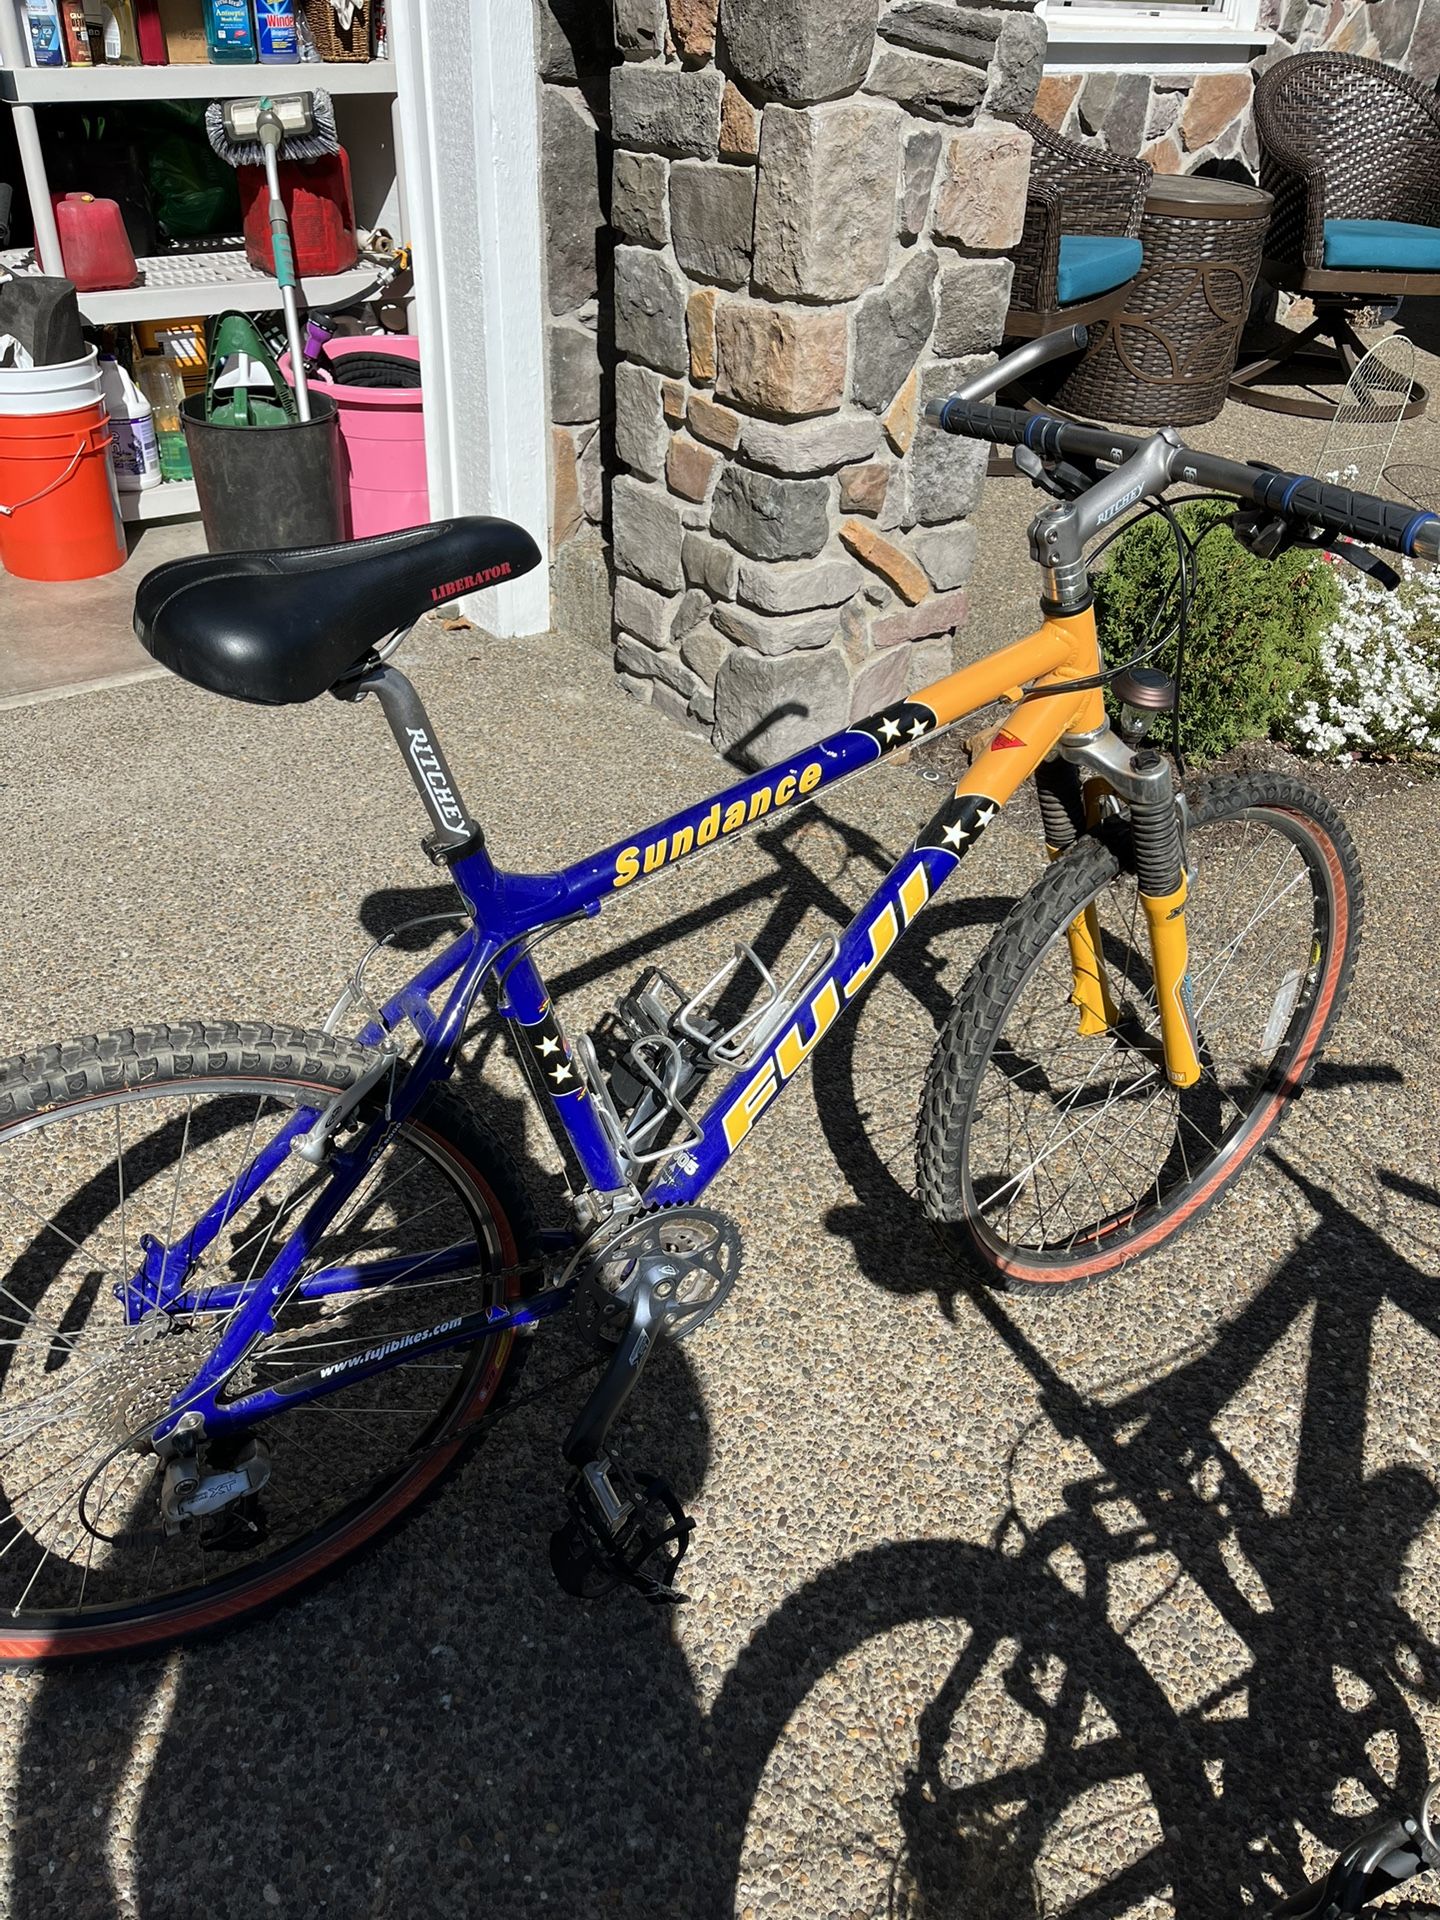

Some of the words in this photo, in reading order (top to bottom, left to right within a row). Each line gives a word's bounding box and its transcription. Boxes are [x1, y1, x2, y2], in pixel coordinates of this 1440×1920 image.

[266, 14, 295, 28] Winde
[1096, 481, 1146, 526] RITCHEY
[430, 562, 512, 602] LIBERATOR
[405, 727, 471, 837] RITCHEY
[613, 762, 823, 887] Sundance
[721, 861, 930, 1154] FUJI
[319, 1316, 463, 1379] www.fujibikes.com
